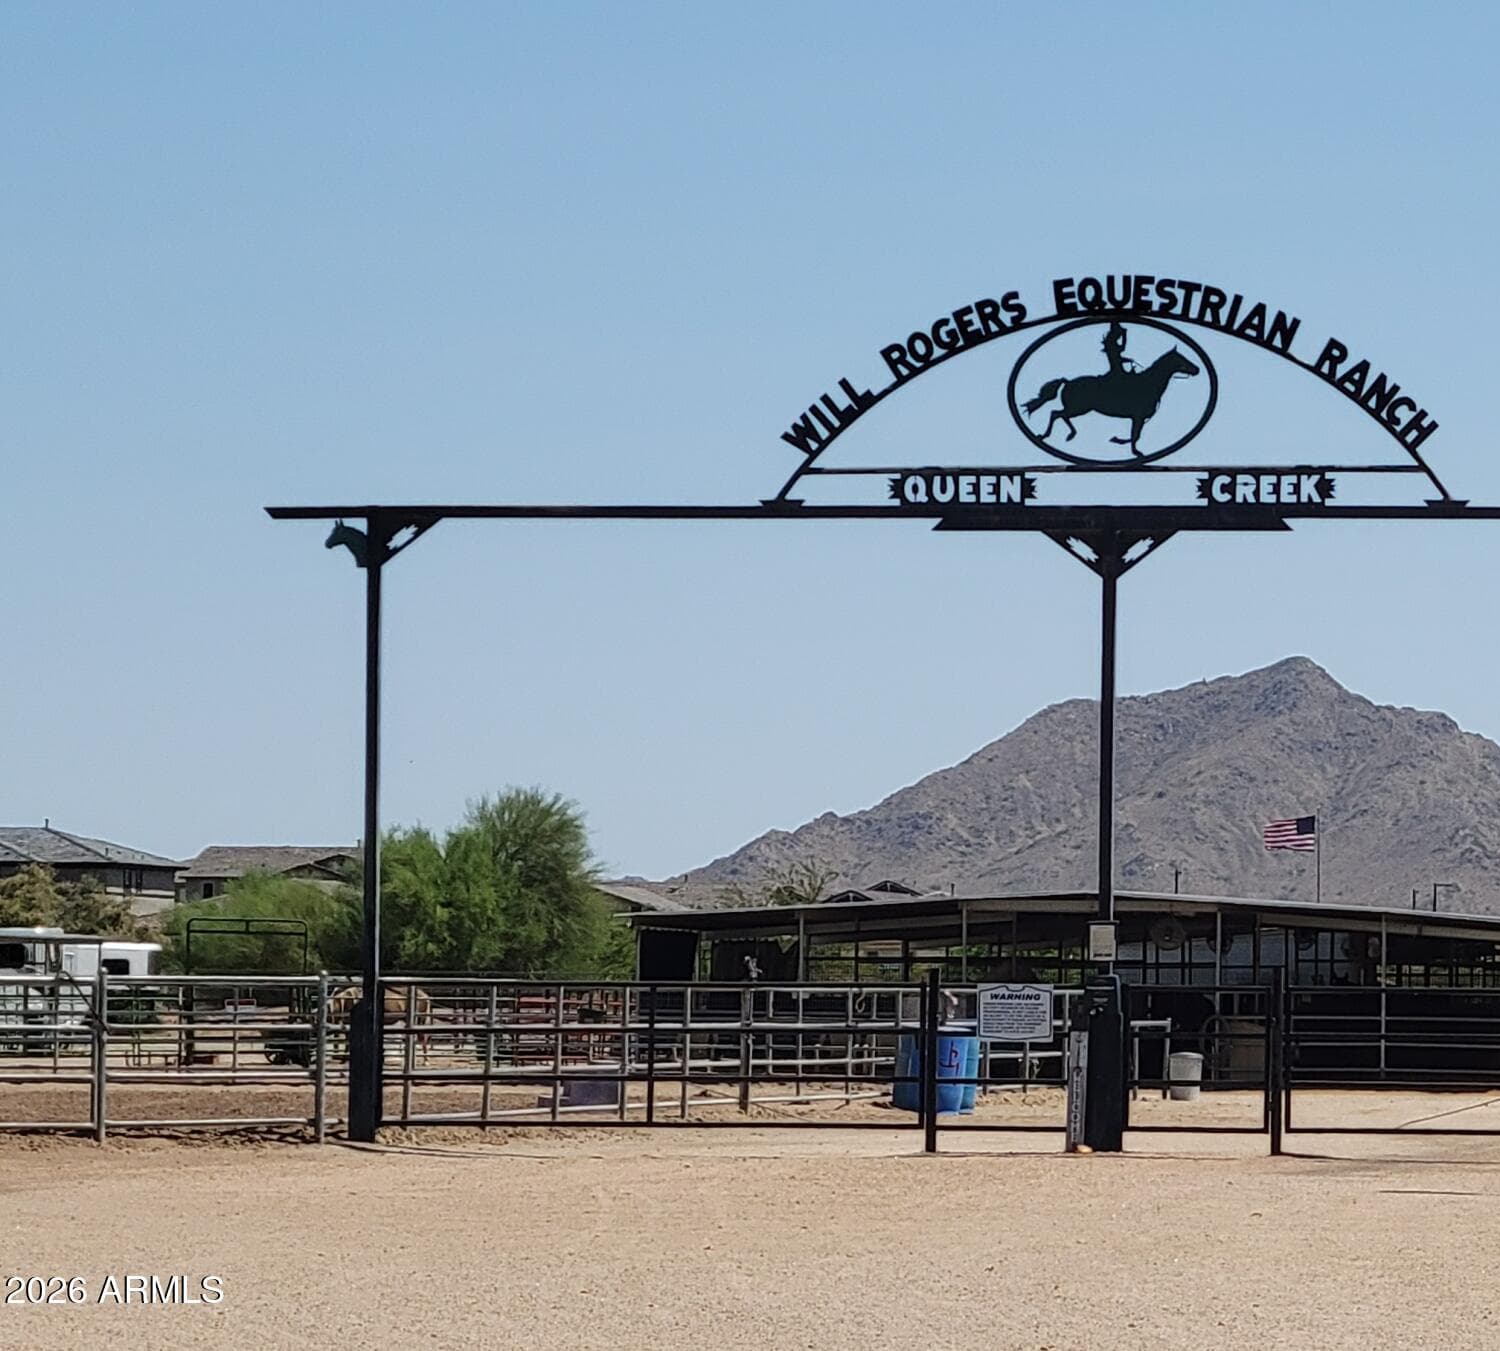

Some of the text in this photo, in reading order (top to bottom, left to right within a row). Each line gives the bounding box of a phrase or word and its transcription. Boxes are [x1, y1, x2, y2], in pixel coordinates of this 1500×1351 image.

[780, 275, 1439, 455] WILL ROGERS EQUESTRIAN RANCH
[903, 474, 1323, 503] QUEEN CREEK
